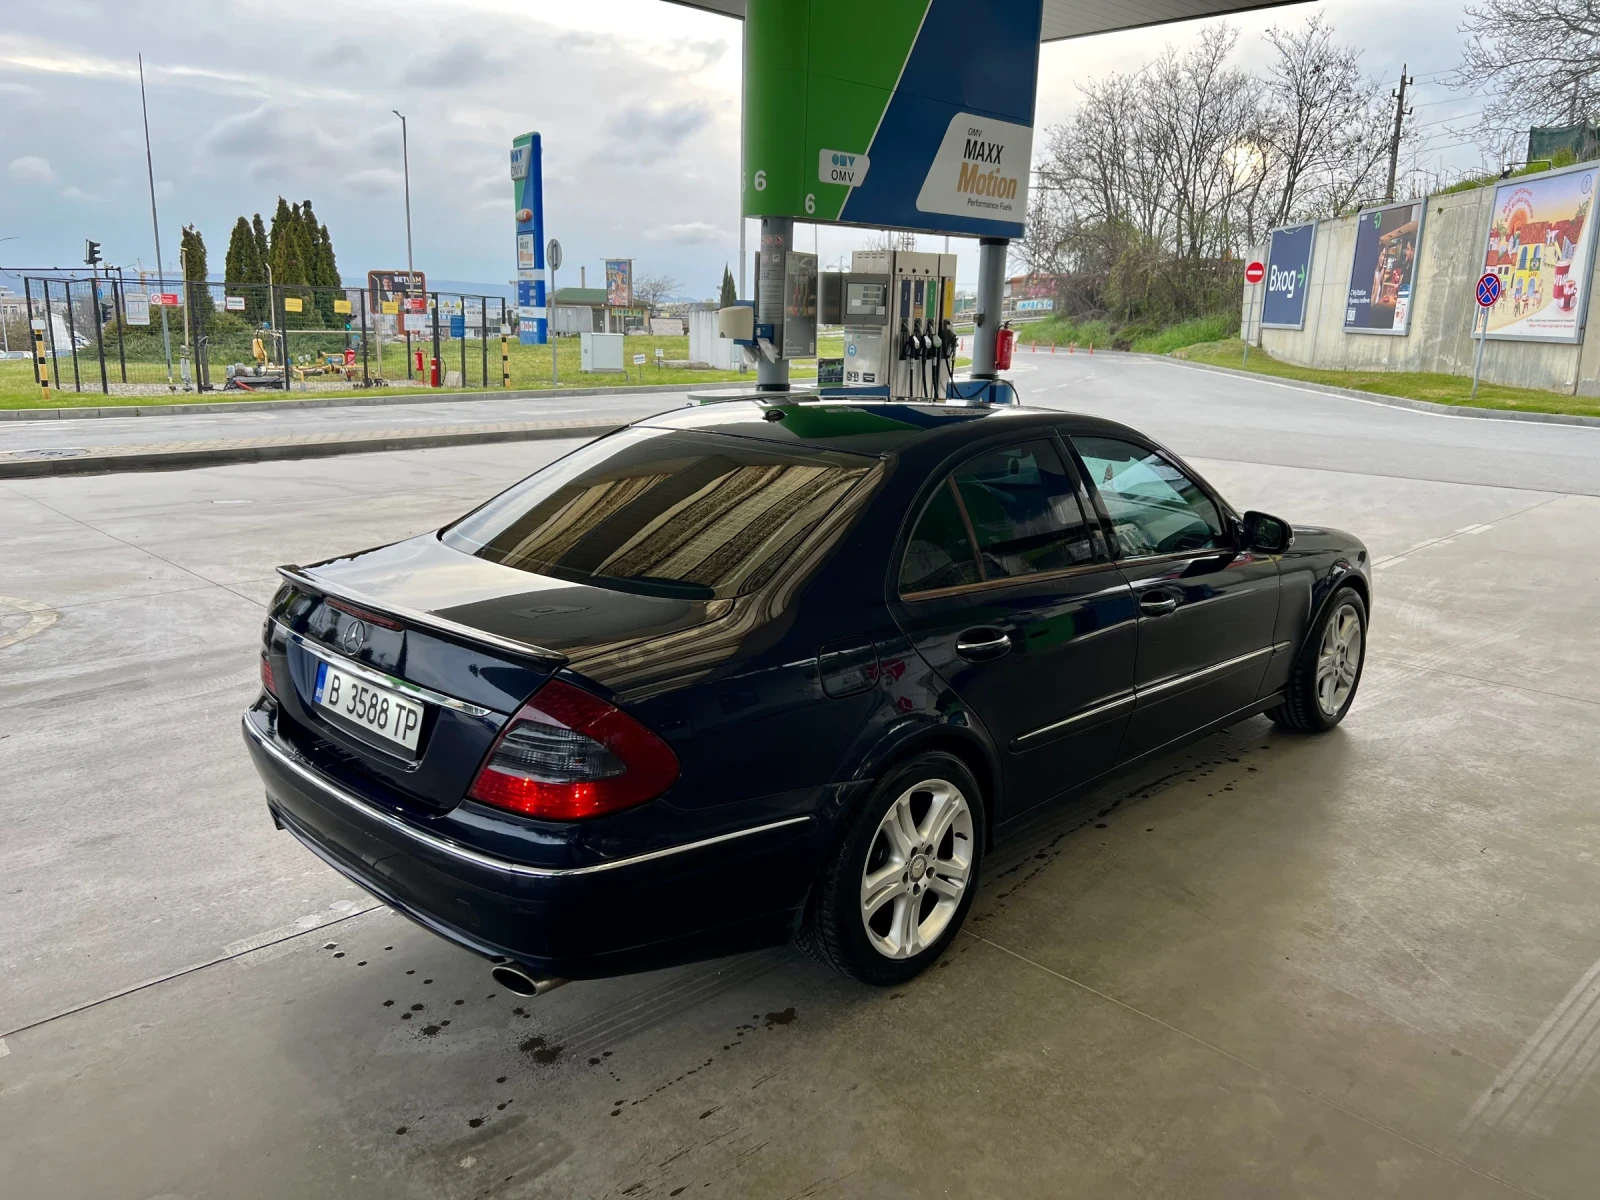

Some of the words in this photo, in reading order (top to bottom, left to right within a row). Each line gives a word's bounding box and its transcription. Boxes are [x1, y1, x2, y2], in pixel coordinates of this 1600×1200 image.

[967, 127, 983, 138] OMV
[963, 138, 1004, 165] MAXX
[754, 170, 767, 191] 6
[831, 169, 855, 182] OMV
[956, 162, 1018, 200] Motion
[804, 193, 816, 214] 6
[967, 198, 999, 211] Performance
[1000, 202, 1013, 212] Fuels
[329, 674, 341, 706] B
[346, 683, 390, 730] 3588
[393, 702, 418, 741] TP
